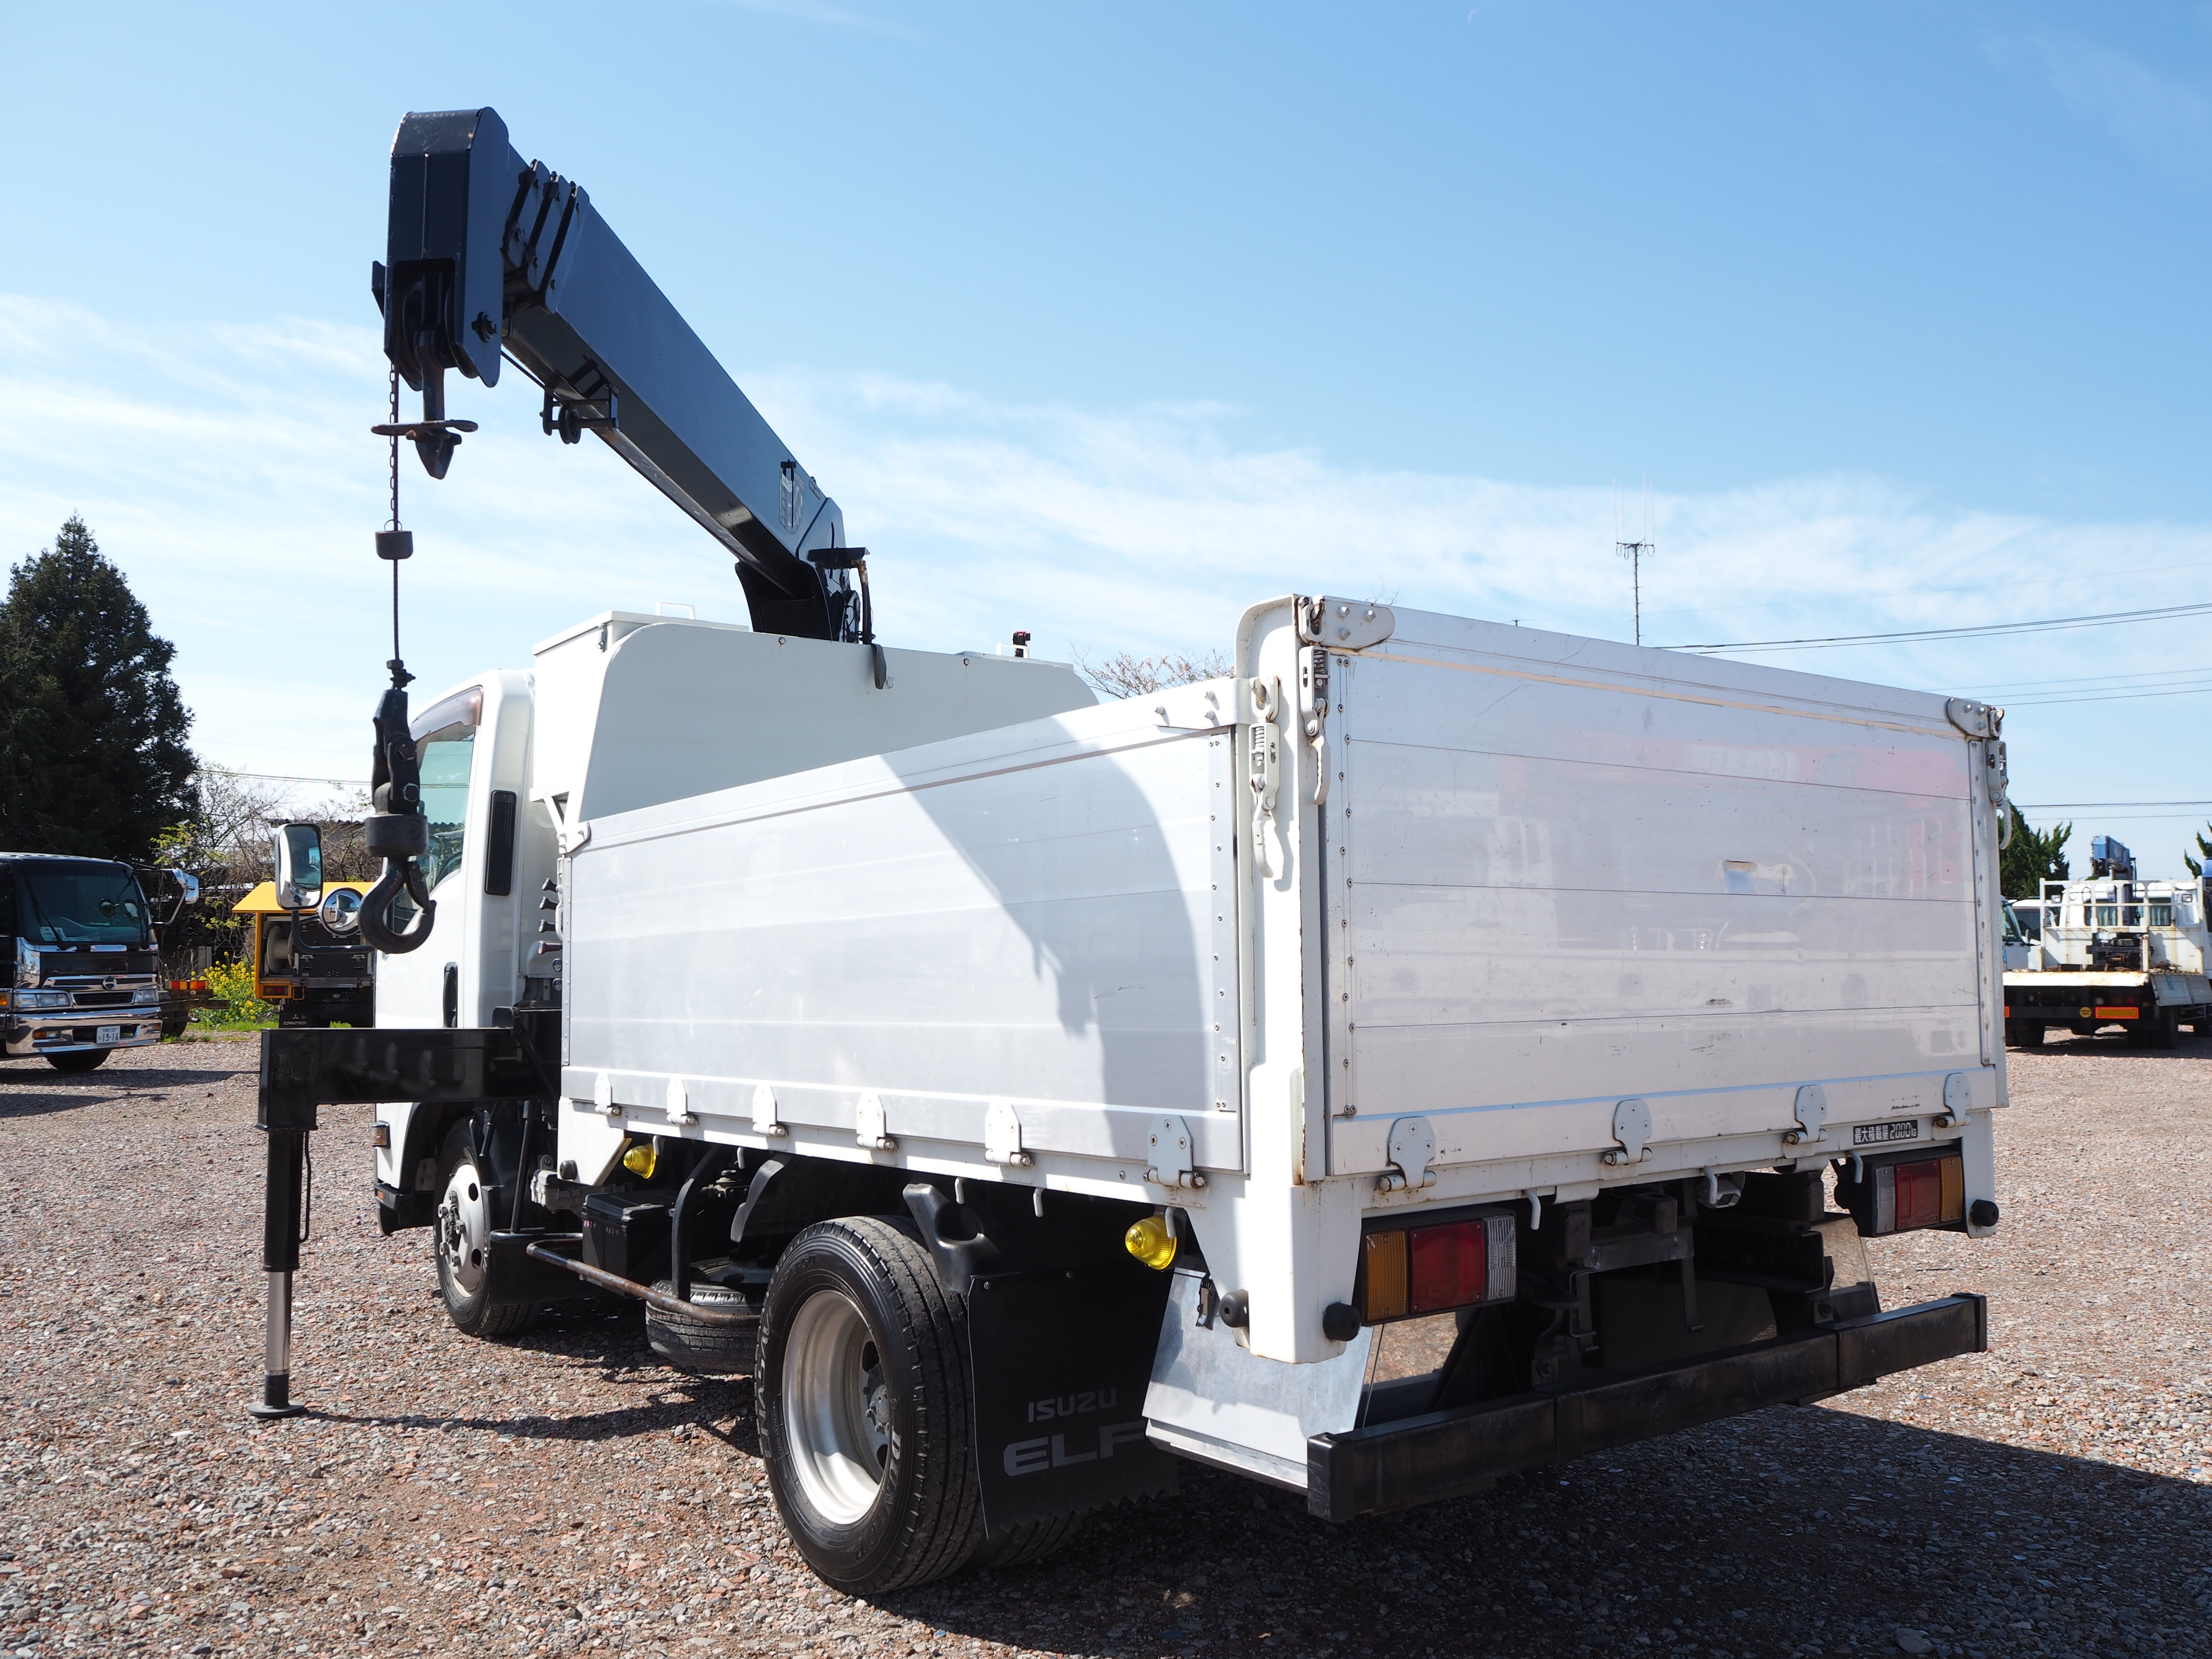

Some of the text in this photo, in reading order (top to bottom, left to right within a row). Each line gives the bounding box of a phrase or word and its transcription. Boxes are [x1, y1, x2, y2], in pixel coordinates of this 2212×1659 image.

[103, 1033, 119, 1042] 19-16
[1854, 1125, 1889, 1143] 最大積載量
[1028, 1387, 1117, 1423] ISUZU
[1003, 1419, 1146, 1477] ELF
[854, 1425, 902, 1562] DUNLOP
